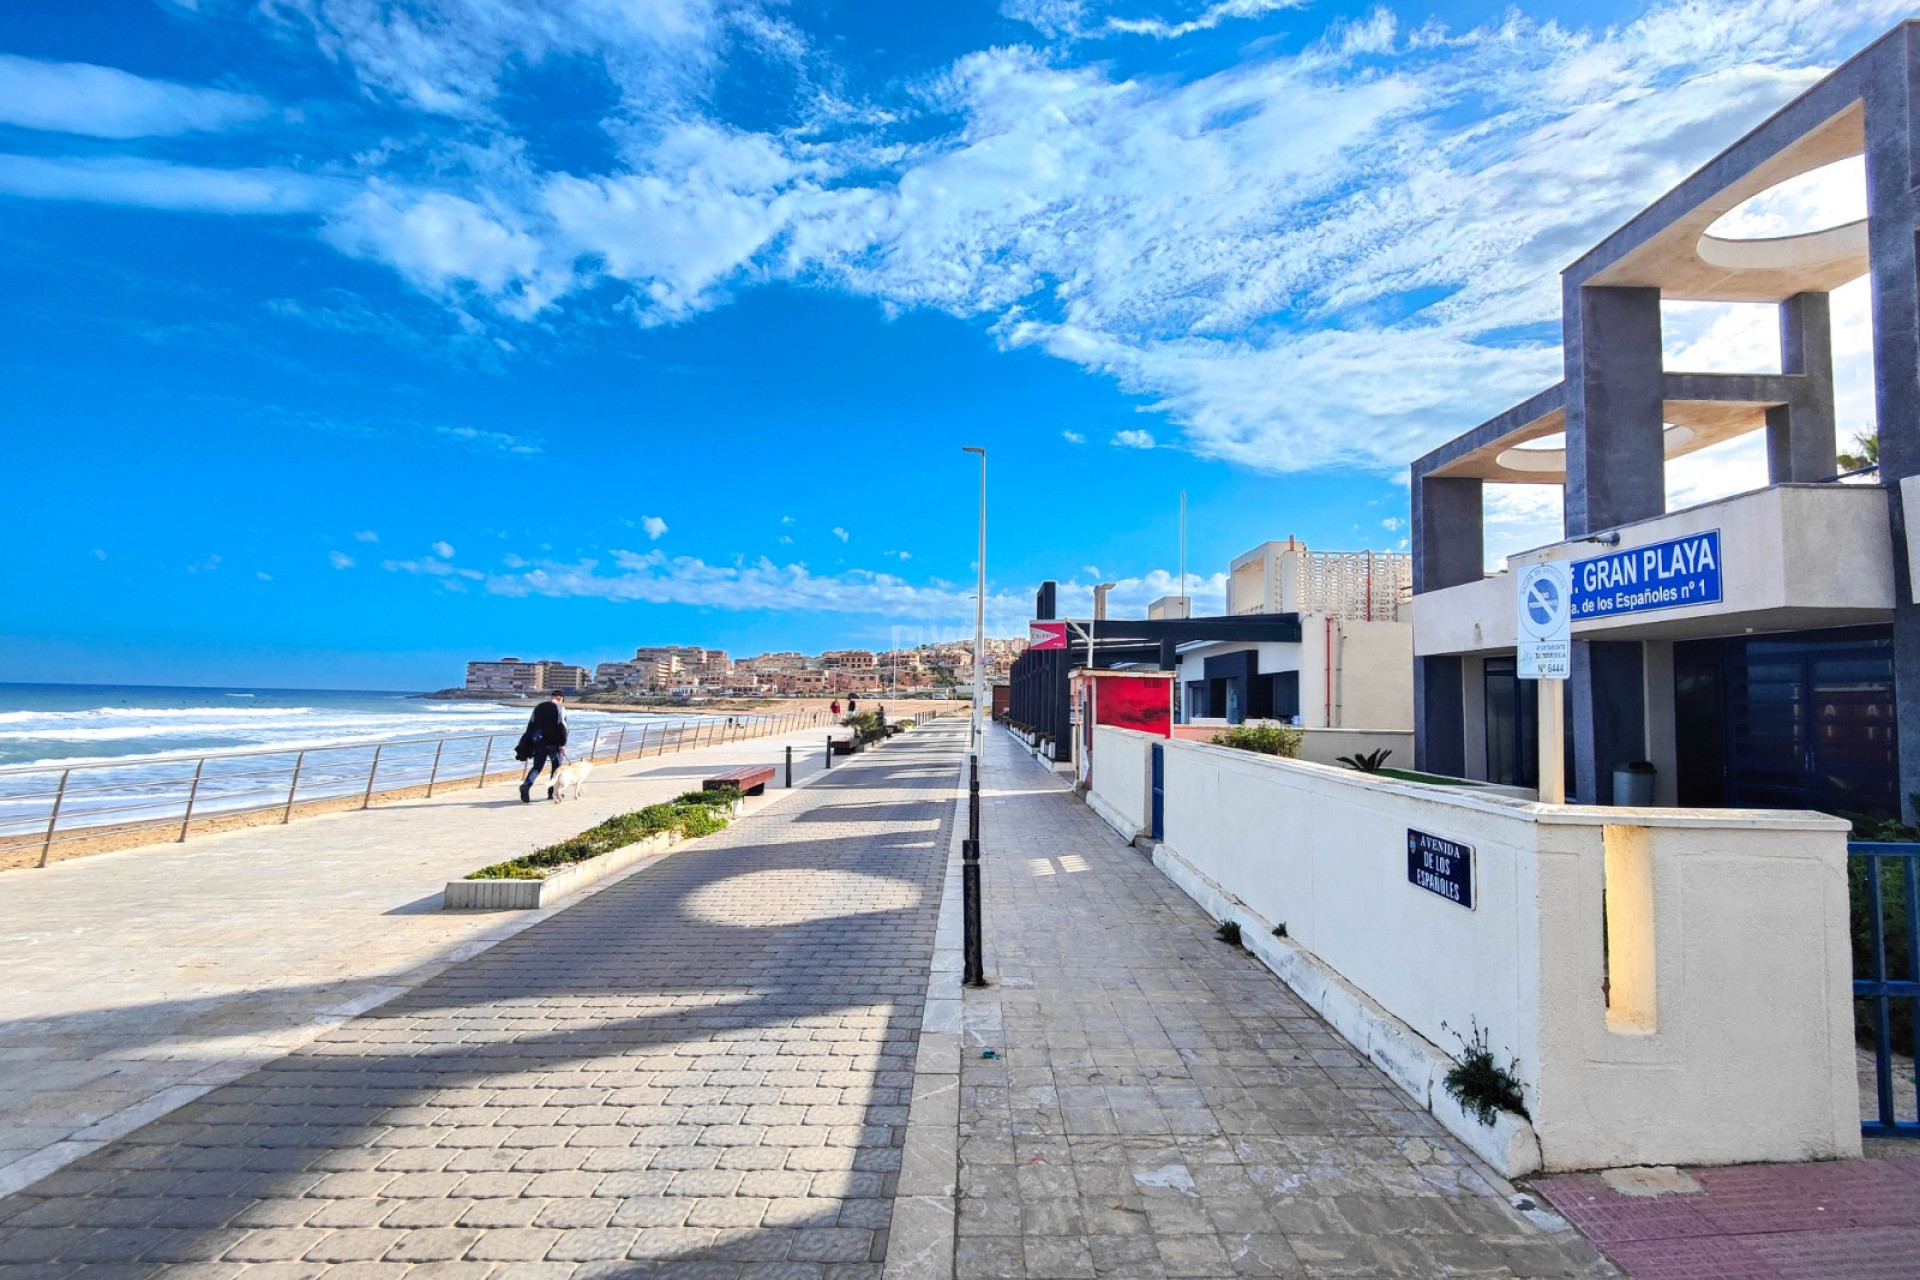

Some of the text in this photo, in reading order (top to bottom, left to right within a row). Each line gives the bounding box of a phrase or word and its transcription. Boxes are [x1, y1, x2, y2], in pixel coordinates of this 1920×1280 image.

[1583, 553, 1637, 592] GRAN
[1643, 538, 1715, 582] PLAYA
[1582, 599, 1594, 612] de
[1597, 597, 1613, 610] los
[1616, 585, 1678, 609] Españoles
[1681, 582, 1695, 598] nº
[1698, 580, 1705, 596] 1
[1420, 835, 1460, 859] AVENIDA
[1423, 851, 1451, 875] DE LOS
[1416, 868, 1460, 901] ESPAÑOLES
